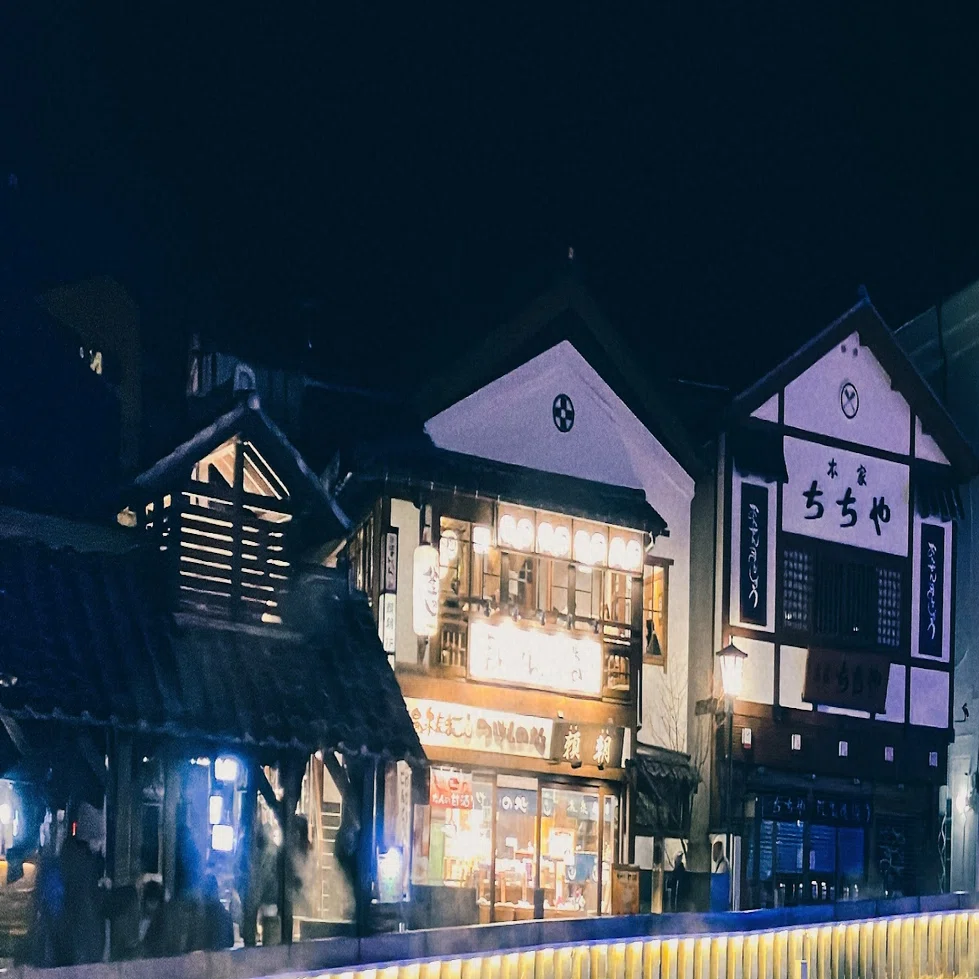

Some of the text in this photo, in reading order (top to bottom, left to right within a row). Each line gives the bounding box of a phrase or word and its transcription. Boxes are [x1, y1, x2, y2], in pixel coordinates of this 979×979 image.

[827, 458, 867, 486] 本家
[803, 480, 891, 536] ちちや
